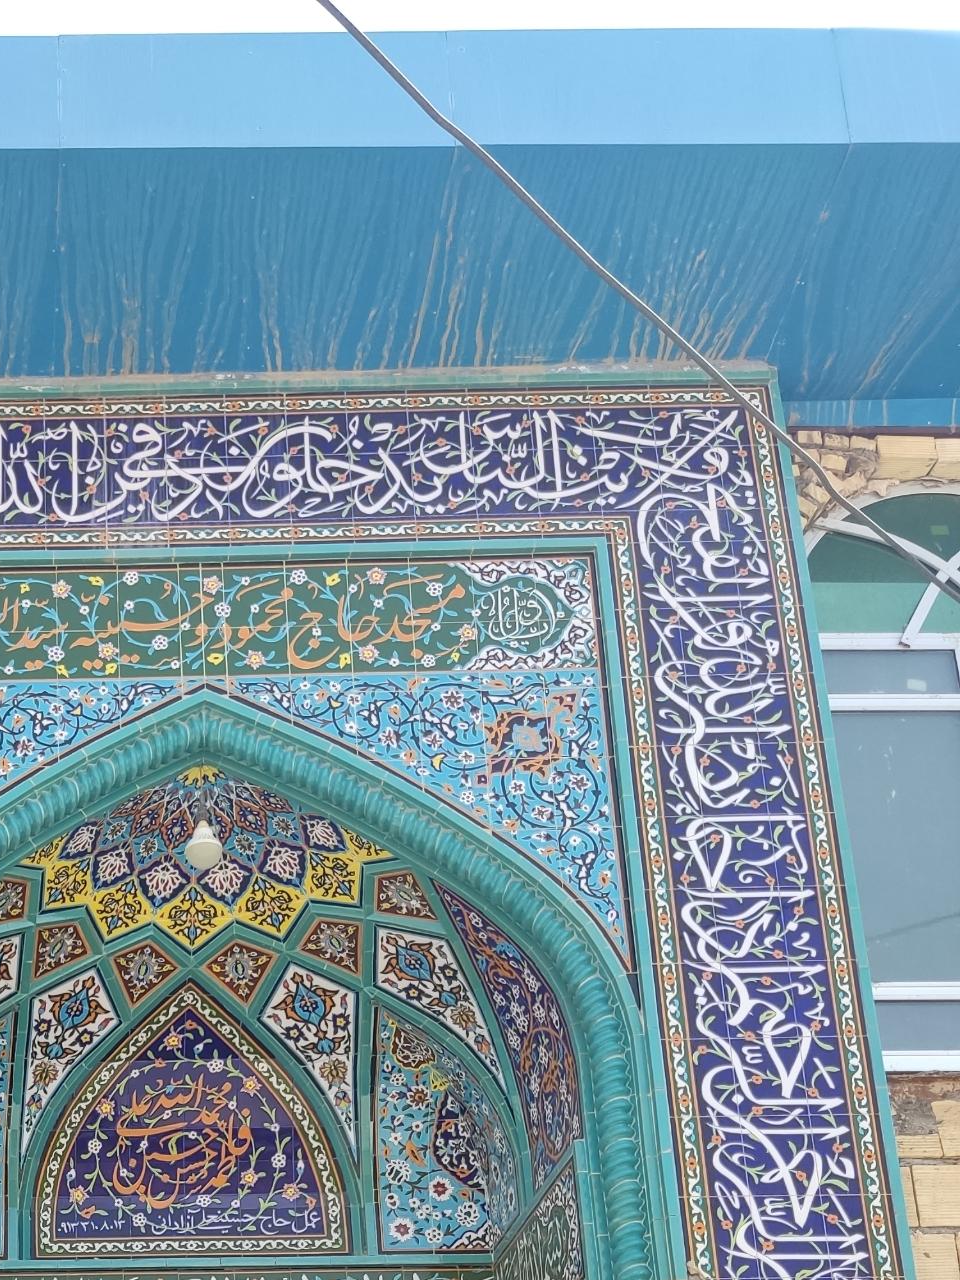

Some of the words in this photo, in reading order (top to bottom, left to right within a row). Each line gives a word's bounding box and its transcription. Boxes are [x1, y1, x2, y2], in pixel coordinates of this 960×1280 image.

[210, 586, 295, 650] محمود
[287, 594, 382, 670] حاج
[369, 583, 466, 658] مسجد
[259, 1208, 291, 1235] حاج
[291, 1208, 321, 1234] عمل
